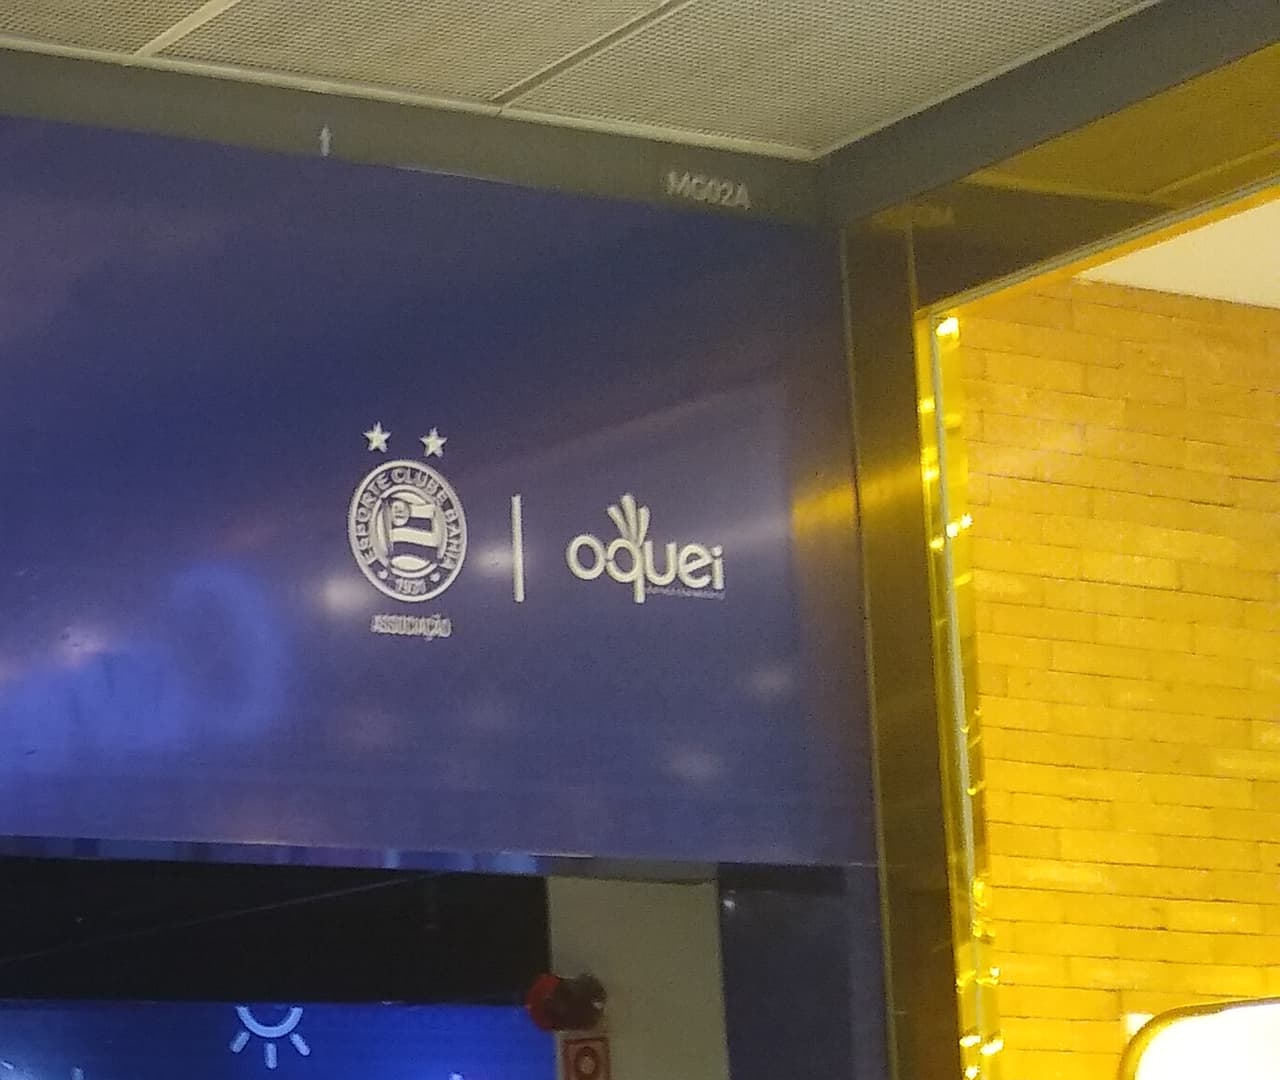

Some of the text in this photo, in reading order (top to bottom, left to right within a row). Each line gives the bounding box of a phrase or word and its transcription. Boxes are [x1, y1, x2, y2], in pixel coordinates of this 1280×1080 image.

[355, 467, 461, 569] ESPORTE CLUBE BAHIA
